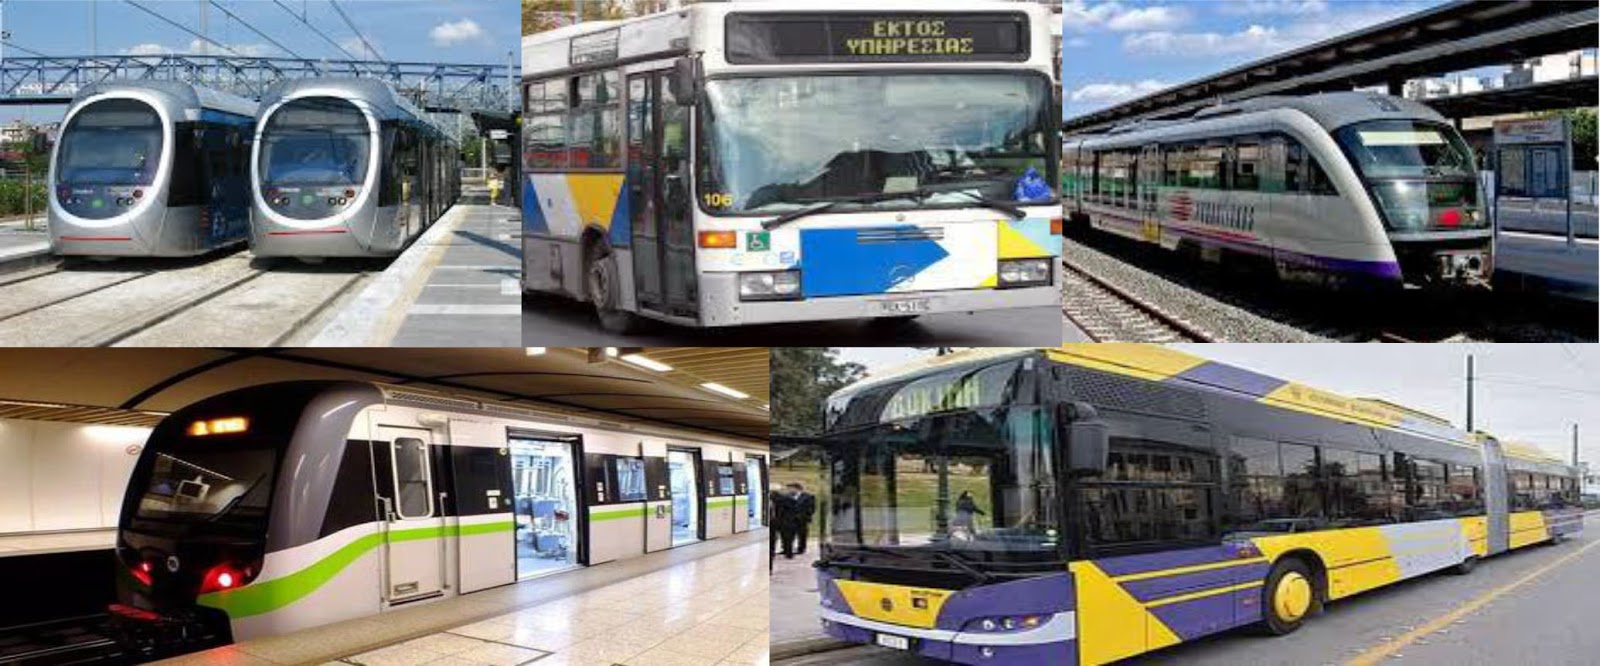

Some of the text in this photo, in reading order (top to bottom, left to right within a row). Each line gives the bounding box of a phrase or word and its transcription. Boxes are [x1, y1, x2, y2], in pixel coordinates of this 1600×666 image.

[873, 20, 945, 37] ΕΚΤΟΣ
[847, 38, 974, 54] ΥΠΗΡΕΣΙΑΣ
[704, 193, 733, 207] 106
